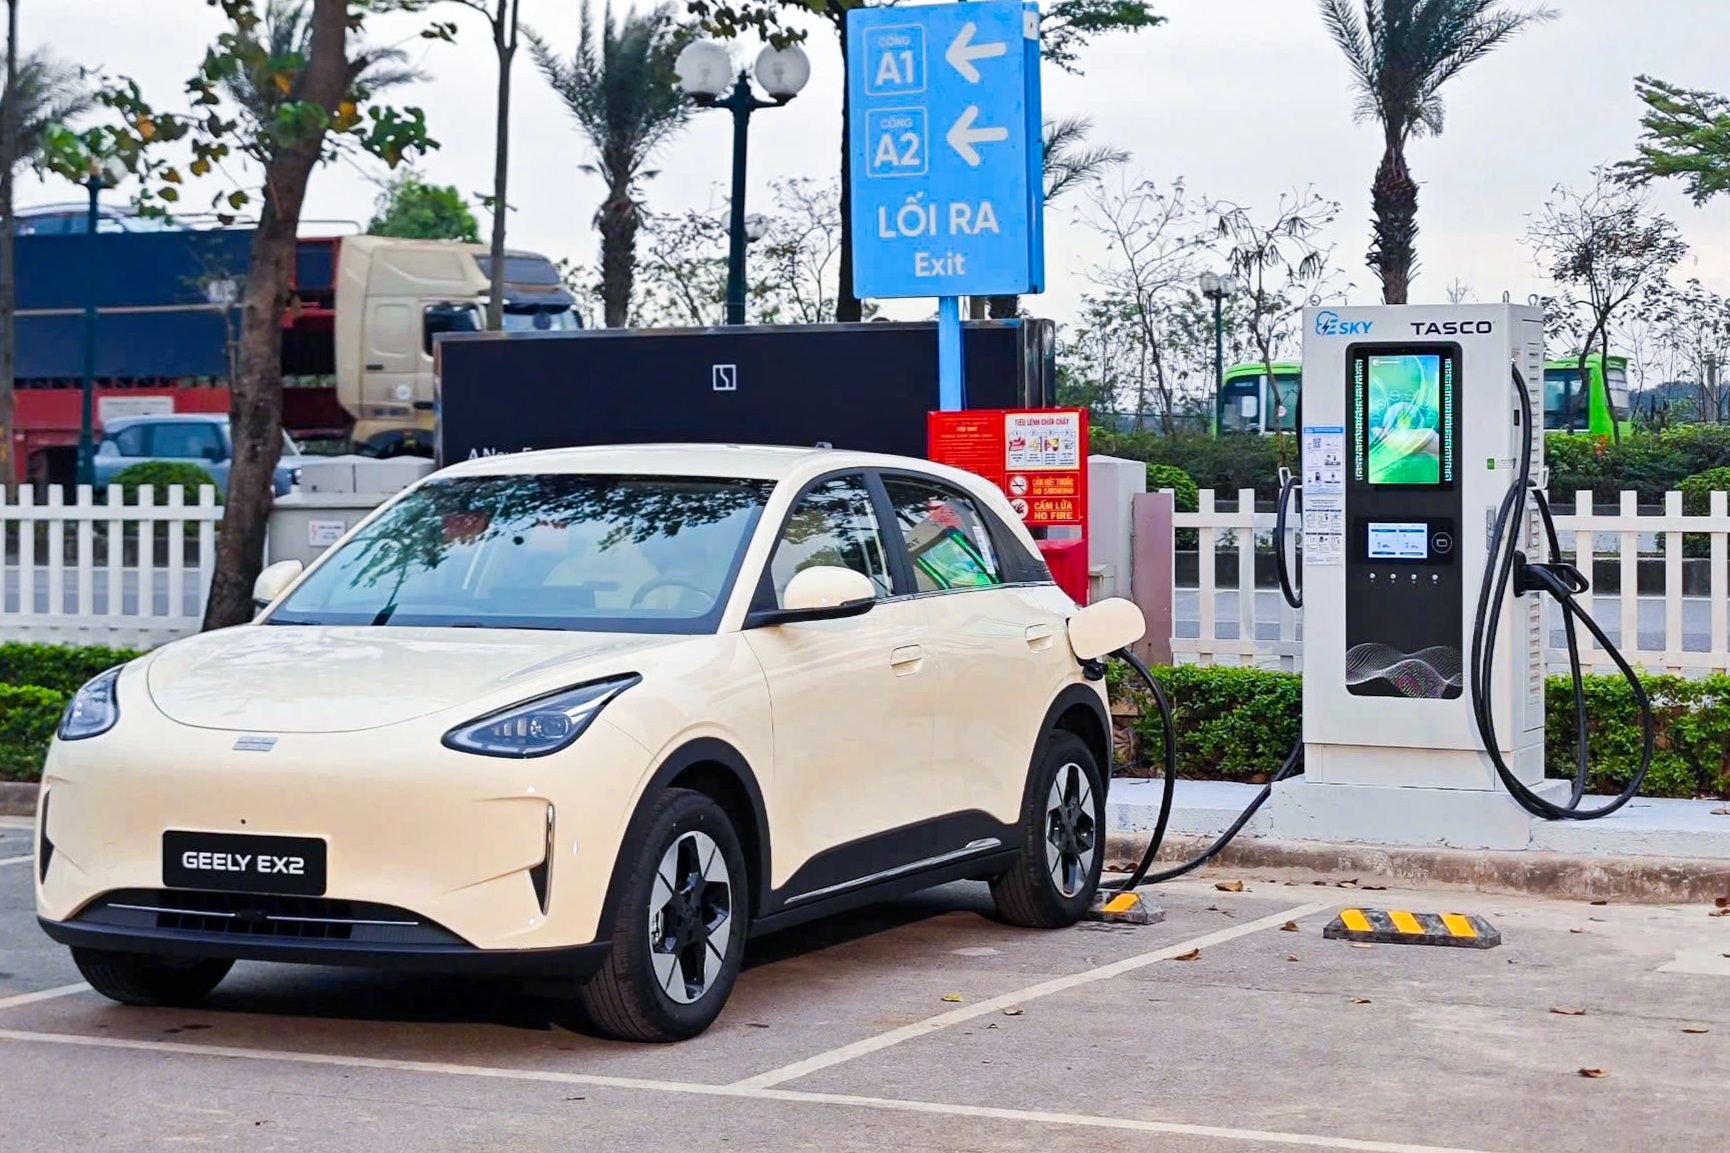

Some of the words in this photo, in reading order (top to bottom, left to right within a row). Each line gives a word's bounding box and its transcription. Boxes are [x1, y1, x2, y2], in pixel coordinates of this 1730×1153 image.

[874, 50, 914, 85] A1
[873, 132, 920, 167] A2
[878, 190, 937, 238] LỐI
[949, 201, 1000, 235] RA
[914, 250, 966, 277] Exit
[1411, 321, 1492, 335] TASCO
[1034, 511, 1047, 520] NO
[1050, 511, 1074, 520] FIRE
[182, 851, 252, 871] GEELY
[257, 855, 305, 875] EX2
